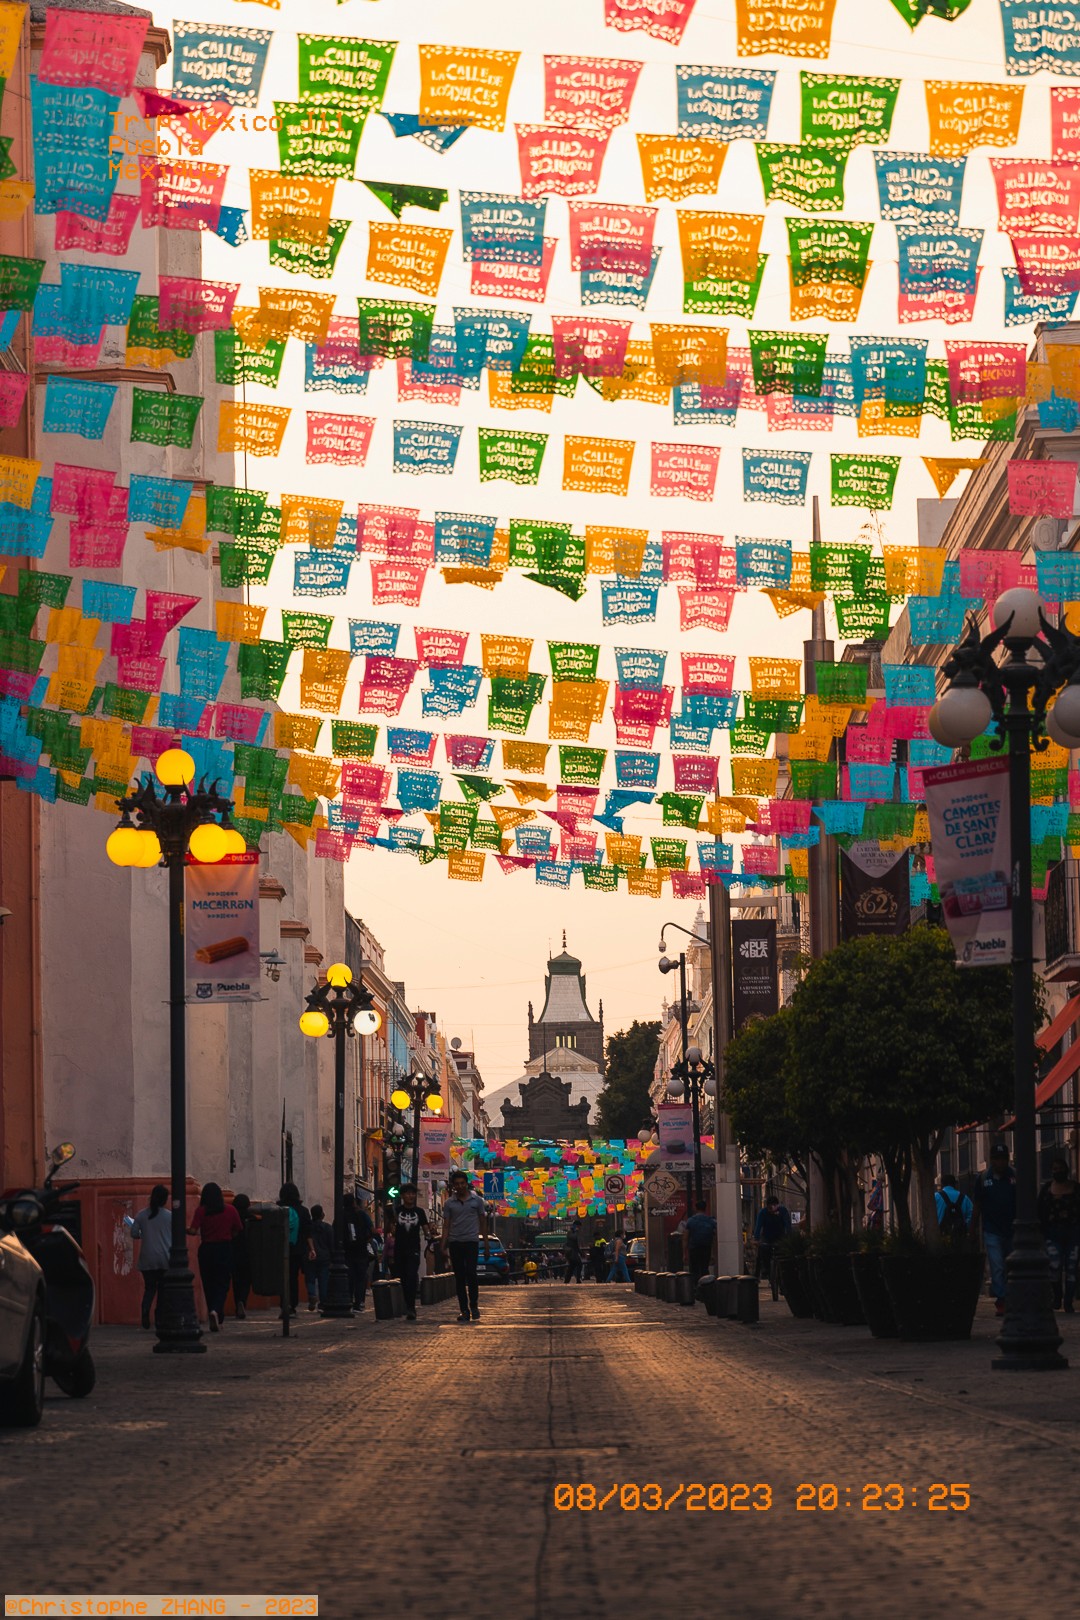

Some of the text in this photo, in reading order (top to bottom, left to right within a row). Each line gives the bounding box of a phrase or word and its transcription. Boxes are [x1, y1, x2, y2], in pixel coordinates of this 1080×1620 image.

[936, 770, 958, 779] CALLE
[976, 761, 1005, 772] DULCES
[945, 816, 998, 836] DE SANT
[863, 894, 888, 914] 62
[974, 938, 1006, 950] Puebla
[217, 983, 250, 991] Puebla
